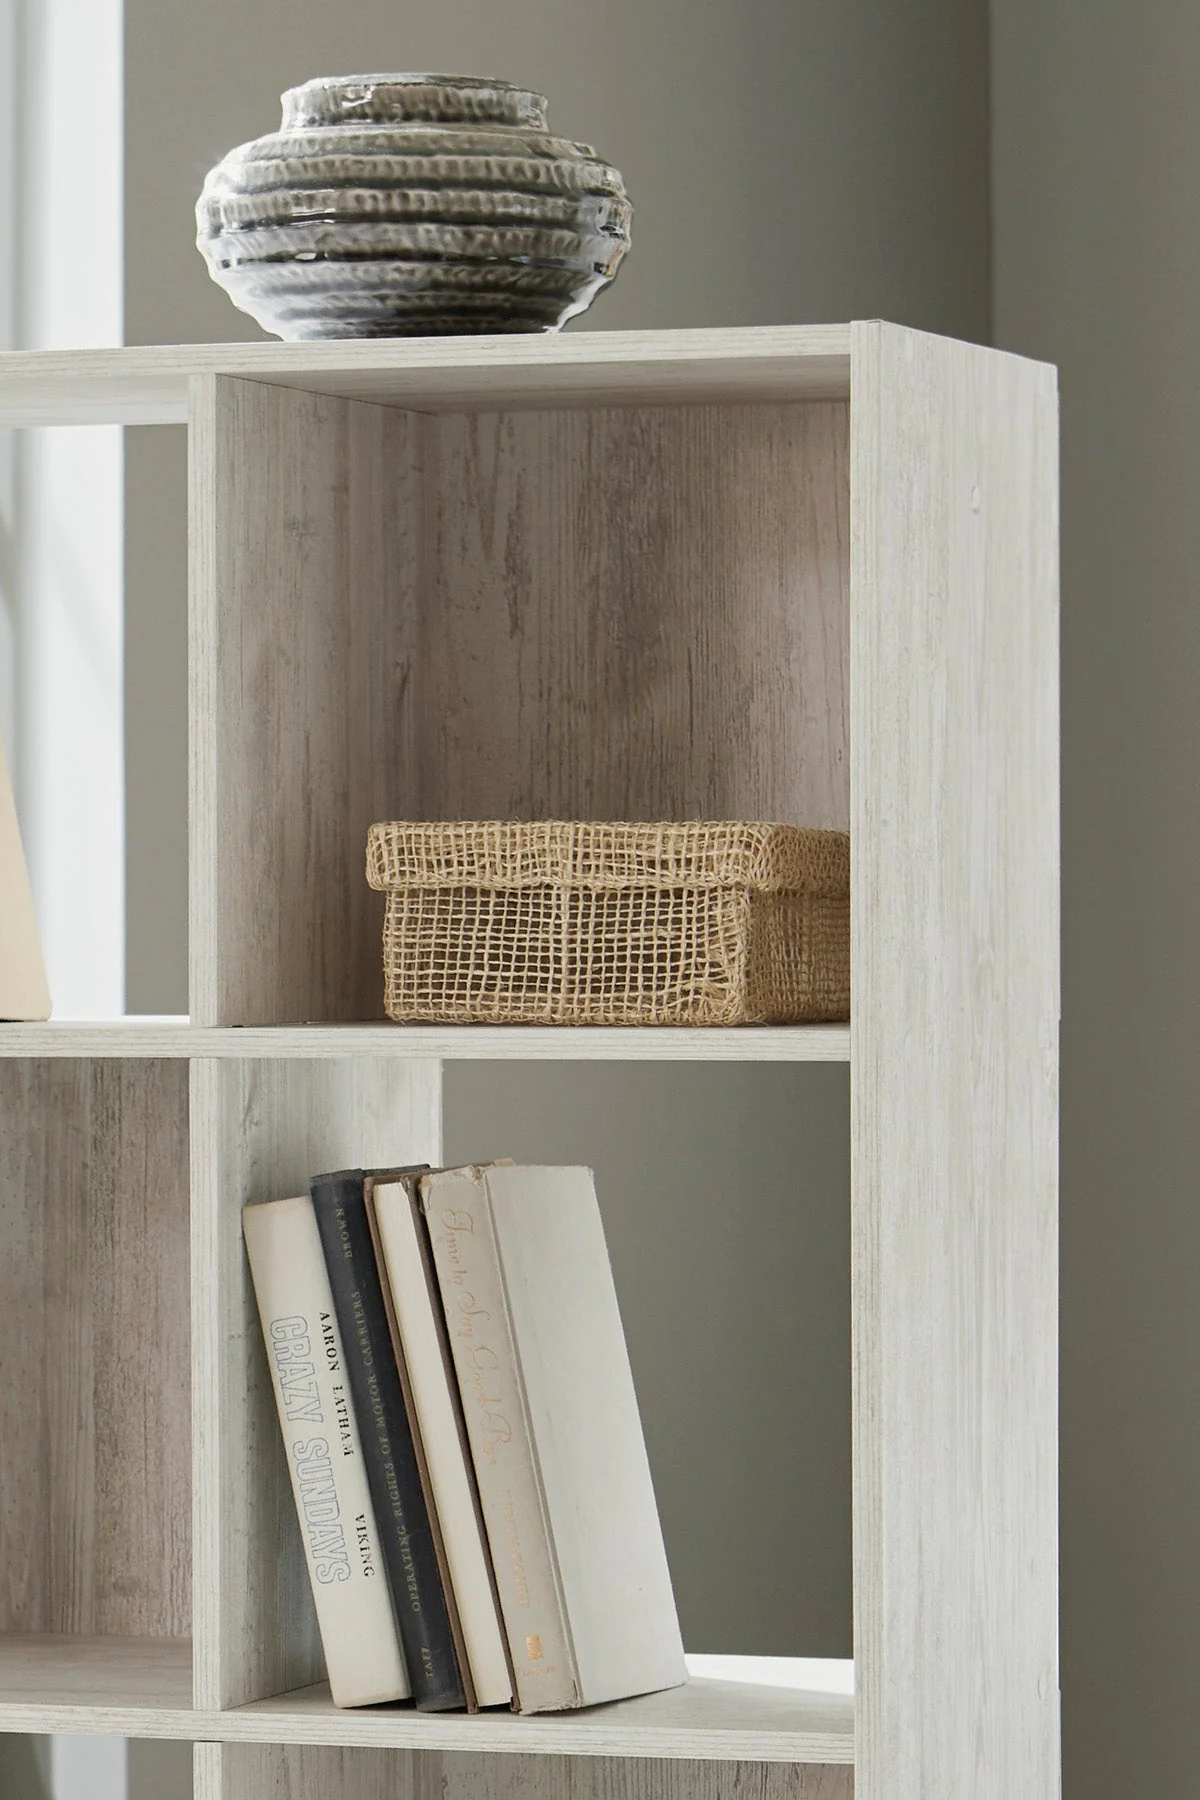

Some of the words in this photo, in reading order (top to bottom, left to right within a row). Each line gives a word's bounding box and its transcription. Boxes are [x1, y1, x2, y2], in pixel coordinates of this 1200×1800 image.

[335, 1207, 353, 1259] BROWN
[452, 1269, 467, 1286] to
[351, 1290, 374, 1367] CARRIERS
[269, 1315, 325, 1423] CRAZY
[319, 1312, 340, 1372] AARON
[332, 1385, 355, 1457] LATHAM
[367, 1373, 386, 1429] MOTOR
[379, 1435, 391, 1455] OF
[292, 1437, 352, 1585] SUNDAYS
[384, 1462, 403, 1518] RIGHTS
[354, 1513, 376, 1578] VIKING
[396, 1524, 421, 1612] OPERATING
